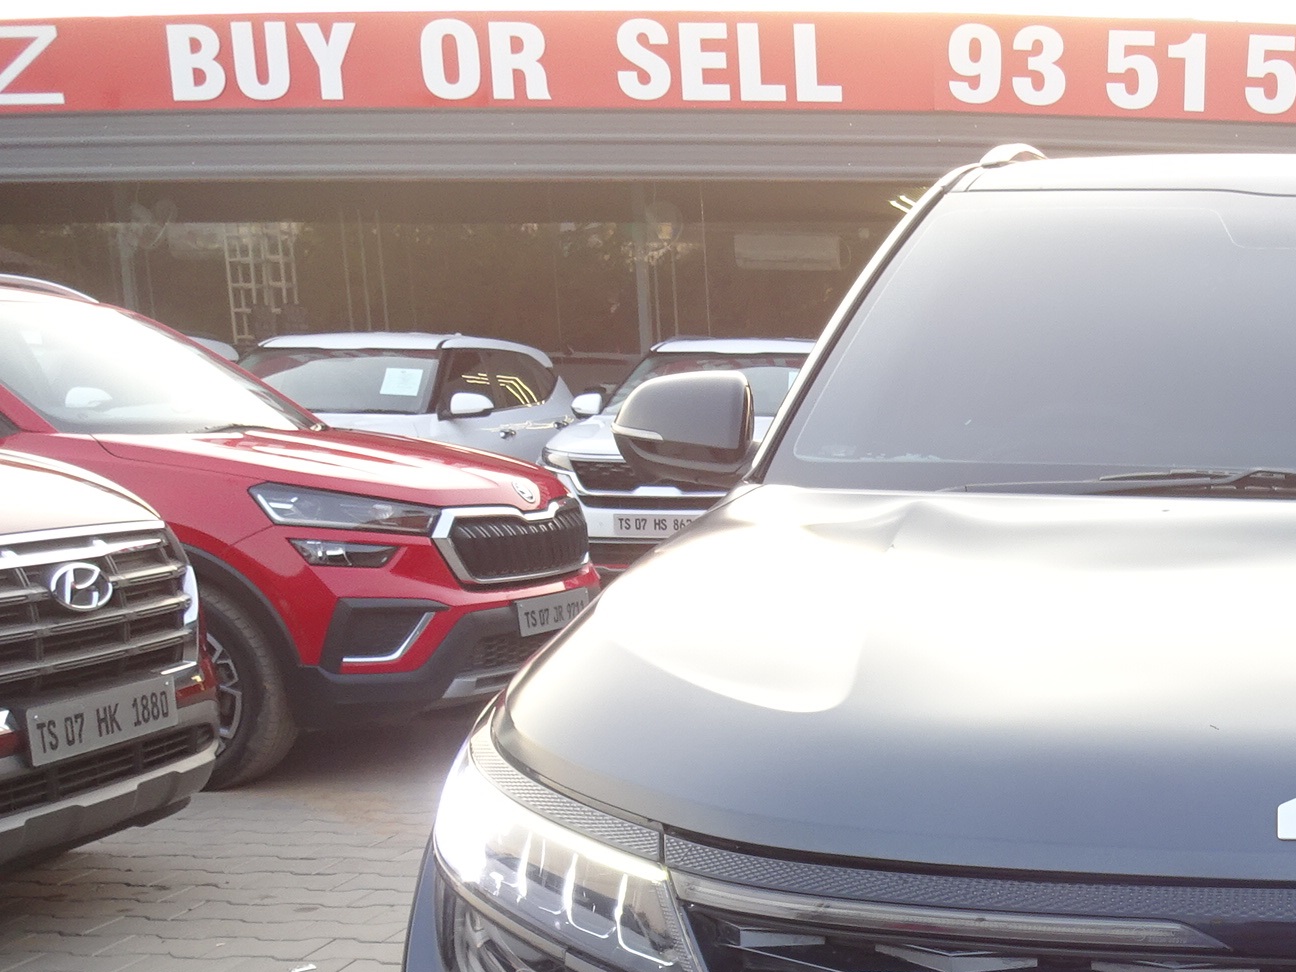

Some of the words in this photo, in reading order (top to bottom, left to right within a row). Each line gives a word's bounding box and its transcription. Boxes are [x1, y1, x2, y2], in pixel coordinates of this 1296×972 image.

[165, 21, 356, 101] BUY
[420, 18, 552, 100] OR
[616, 18, 842, 102] SELL
[948, 23, 1066, 106] 93
[1105, 30, 1207, 112] 51
[618, 518, 631, 530] TS
[635, 518, 647, 530] 07
[654, 518, 668, 530] HS
[673, 518, 693, 530] 86
[524, 610, 537, 628] TS
[539, 608, 550, 625] 07
[36, 719, 59, 754] TS
[64, 712, 85, 747] 07
[96, 703, 122, 737] HK
[131, 690, 170, 727] 1880
